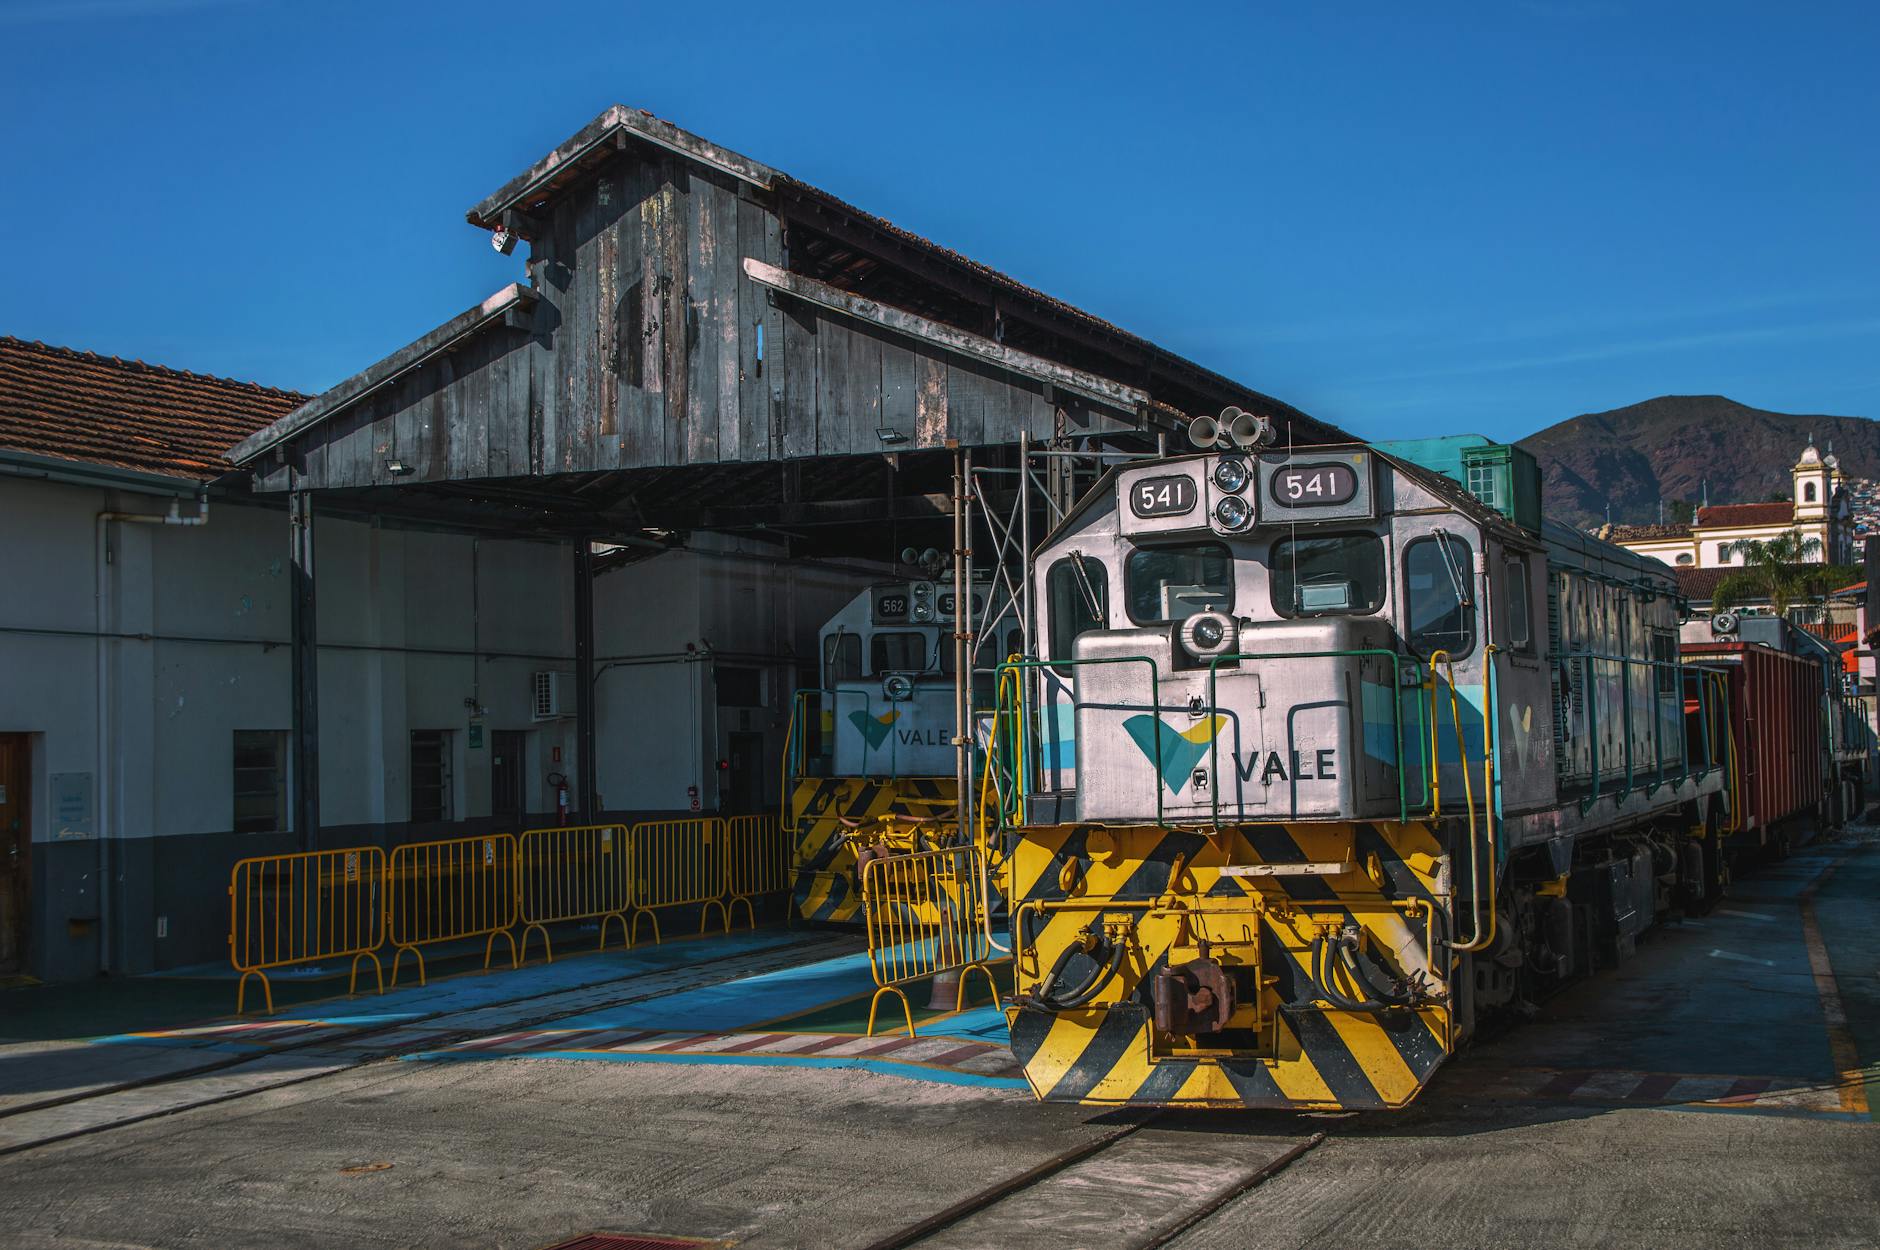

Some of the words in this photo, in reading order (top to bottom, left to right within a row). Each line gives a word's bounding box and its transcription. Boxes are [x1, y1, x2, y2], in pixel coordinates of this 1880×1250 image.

[1141, 483, 1182, 510] 541
[1287, 472, 1336, 499] 541
[883, 600, 904, 613] 562
[897, 729, 948, 746] VALE
[1231, 750, 1337, 782] VALE
